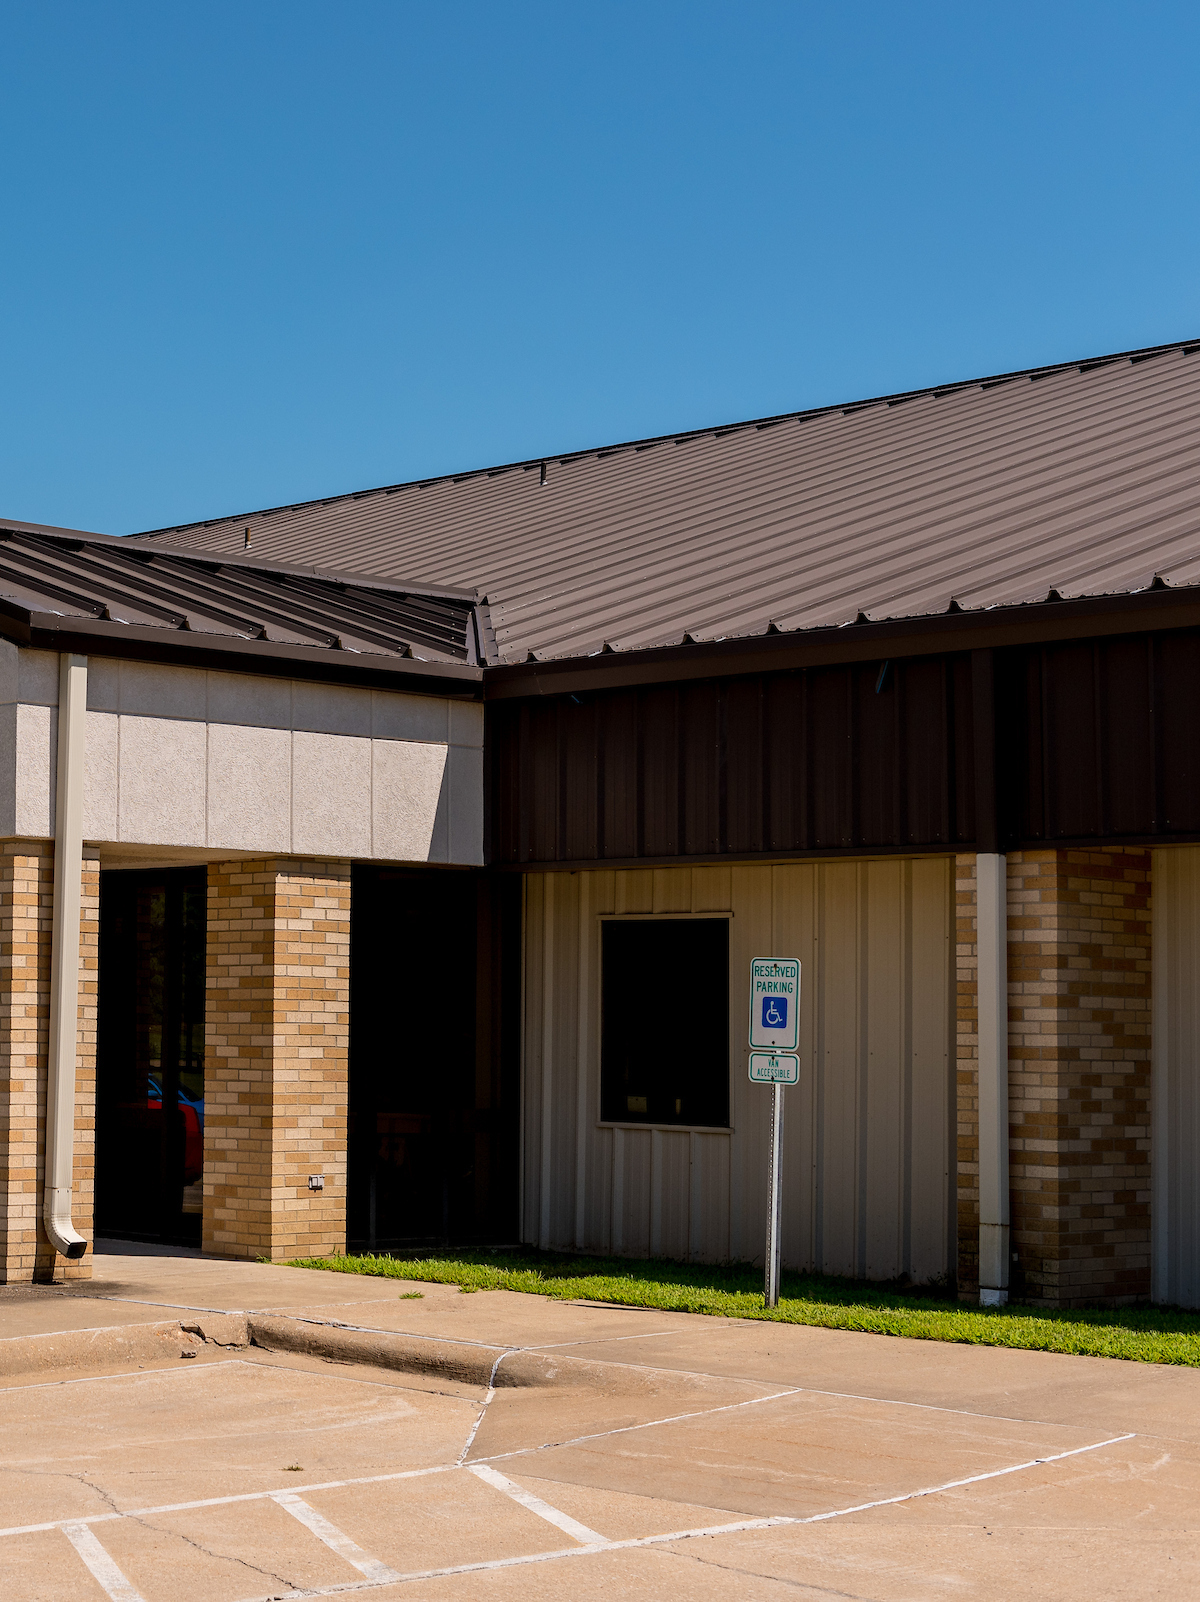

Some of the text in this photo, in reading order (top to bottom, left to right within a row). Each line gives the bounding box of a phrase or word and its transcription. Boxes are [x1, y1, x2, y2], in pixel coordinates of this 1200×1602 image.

[754, 965, 796, 978] RESERVED
[756, 981, 793, 993] PARKING
[768, 1059, 779, 1068] VAN
[757, 1068, 790, 1079] ACCESSIBLE
